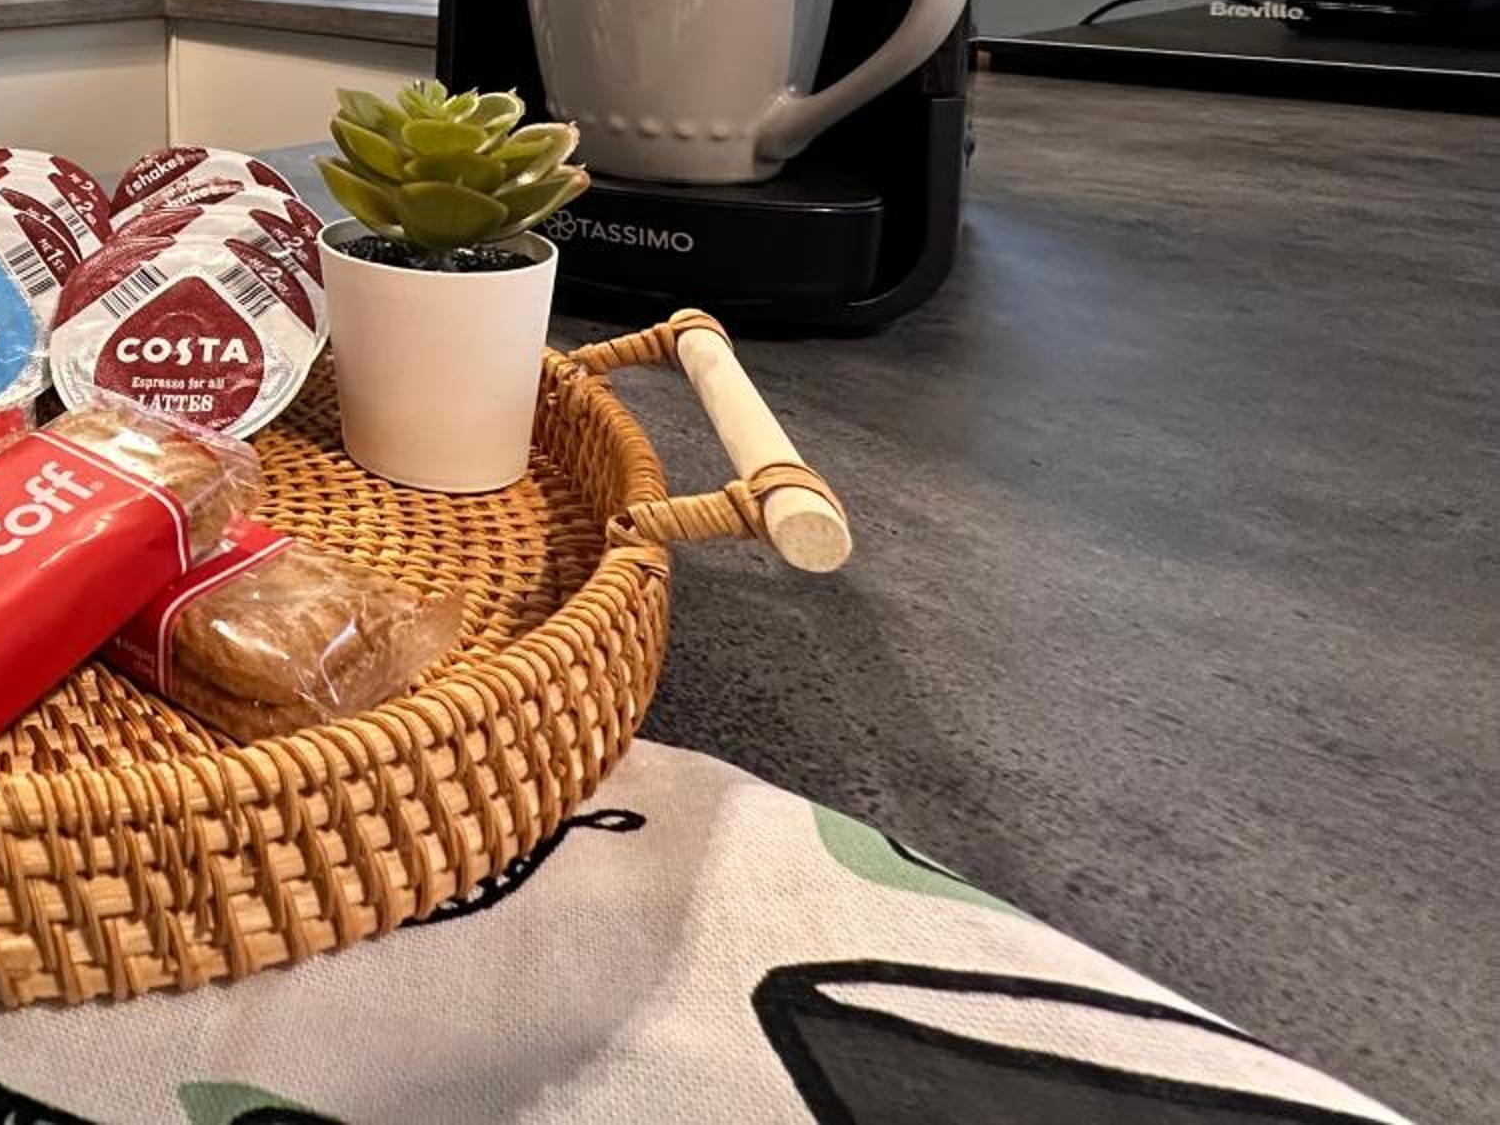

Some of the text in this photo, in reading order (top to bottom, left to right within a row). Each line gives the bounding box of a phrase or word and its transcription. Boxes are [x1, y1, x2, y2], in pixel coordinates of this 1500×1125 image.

[1209, 0, 1305, 21] Breville
[575, 218, 694, 253] TASSIMO
[116, 336, 249, 366] COSTA
[131, 376, 185, 390] Espresso
[187, 376, 205, 389] for
[138, 393, 215, 413] LATTES
